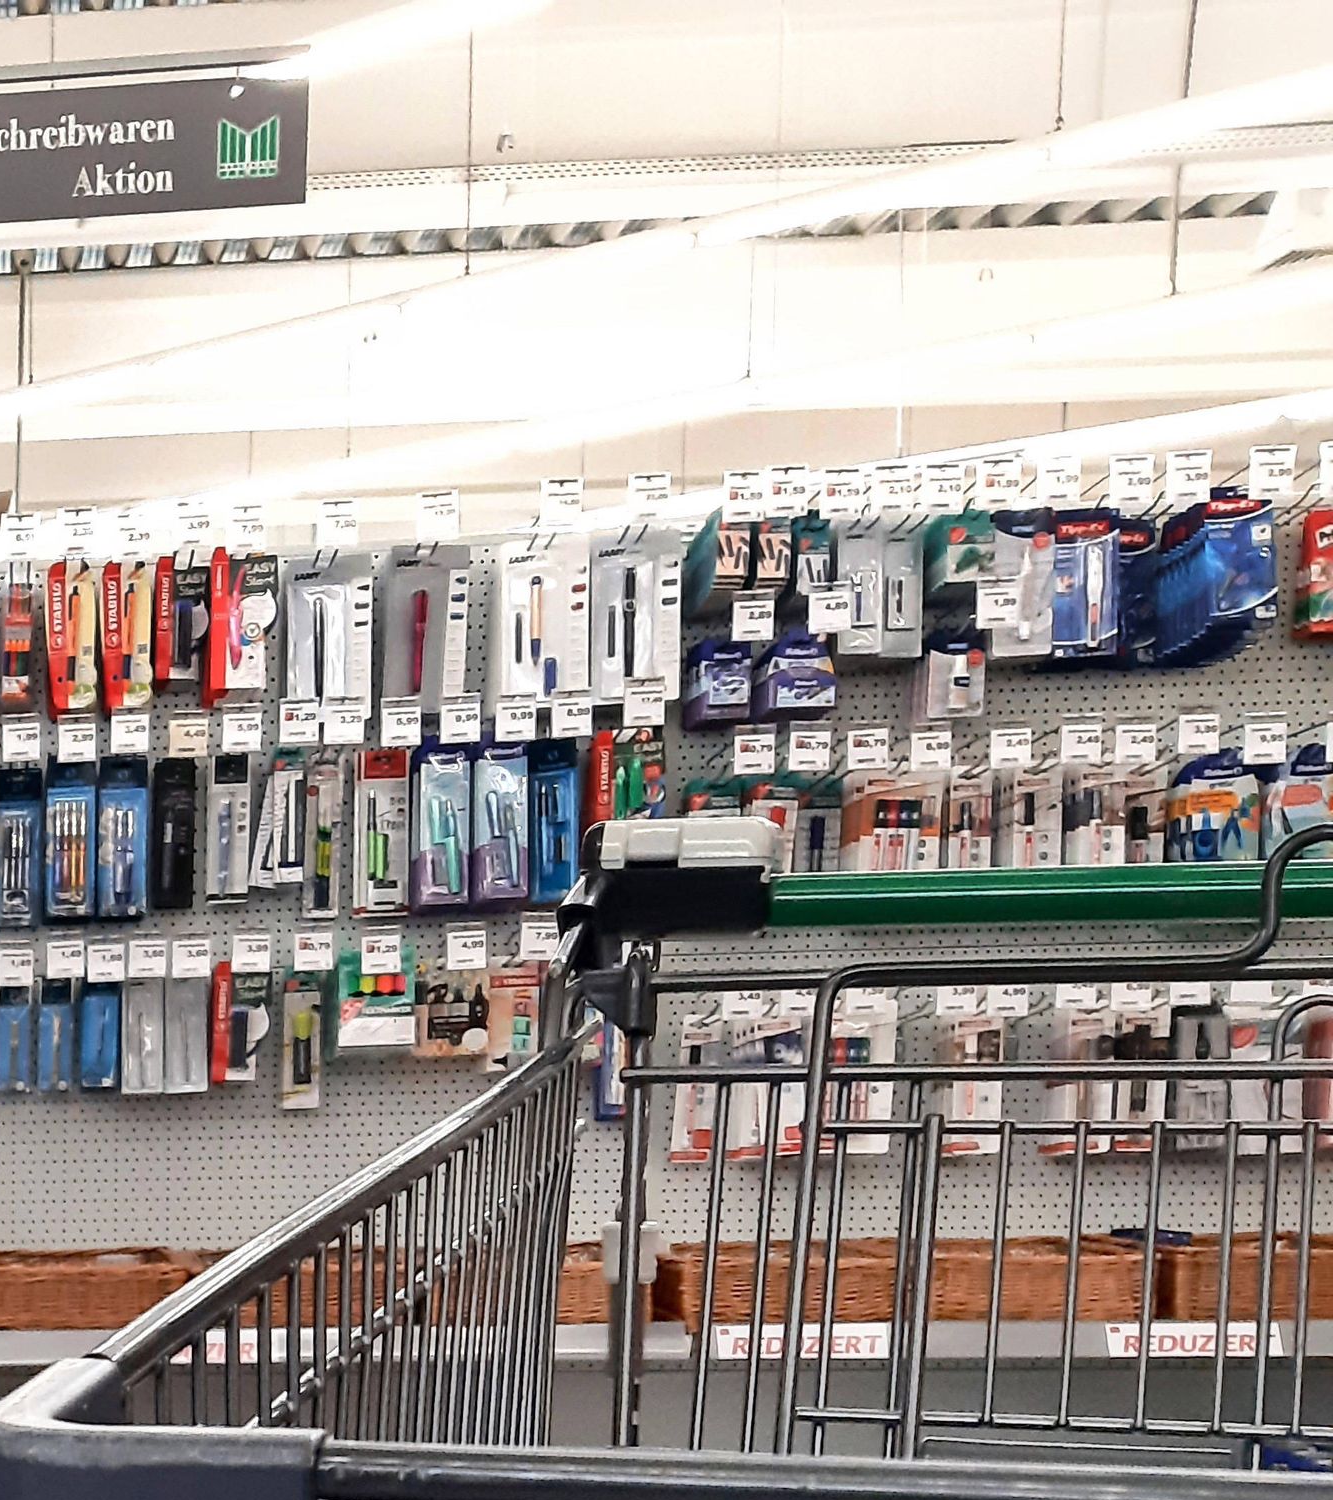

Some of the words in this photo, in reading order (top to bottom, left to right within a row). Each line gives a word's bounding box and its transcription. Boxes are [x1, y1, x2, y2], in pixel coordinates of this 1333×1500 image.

[72, 162, 174, 199] Aktion
[52, 582, 63, 633] STABILO
[107, 580, 118, 631] STABILO
[732, 1335, 882, 1355] RDZERT
[1124, 1334, 1276, 1353] REDUZER
